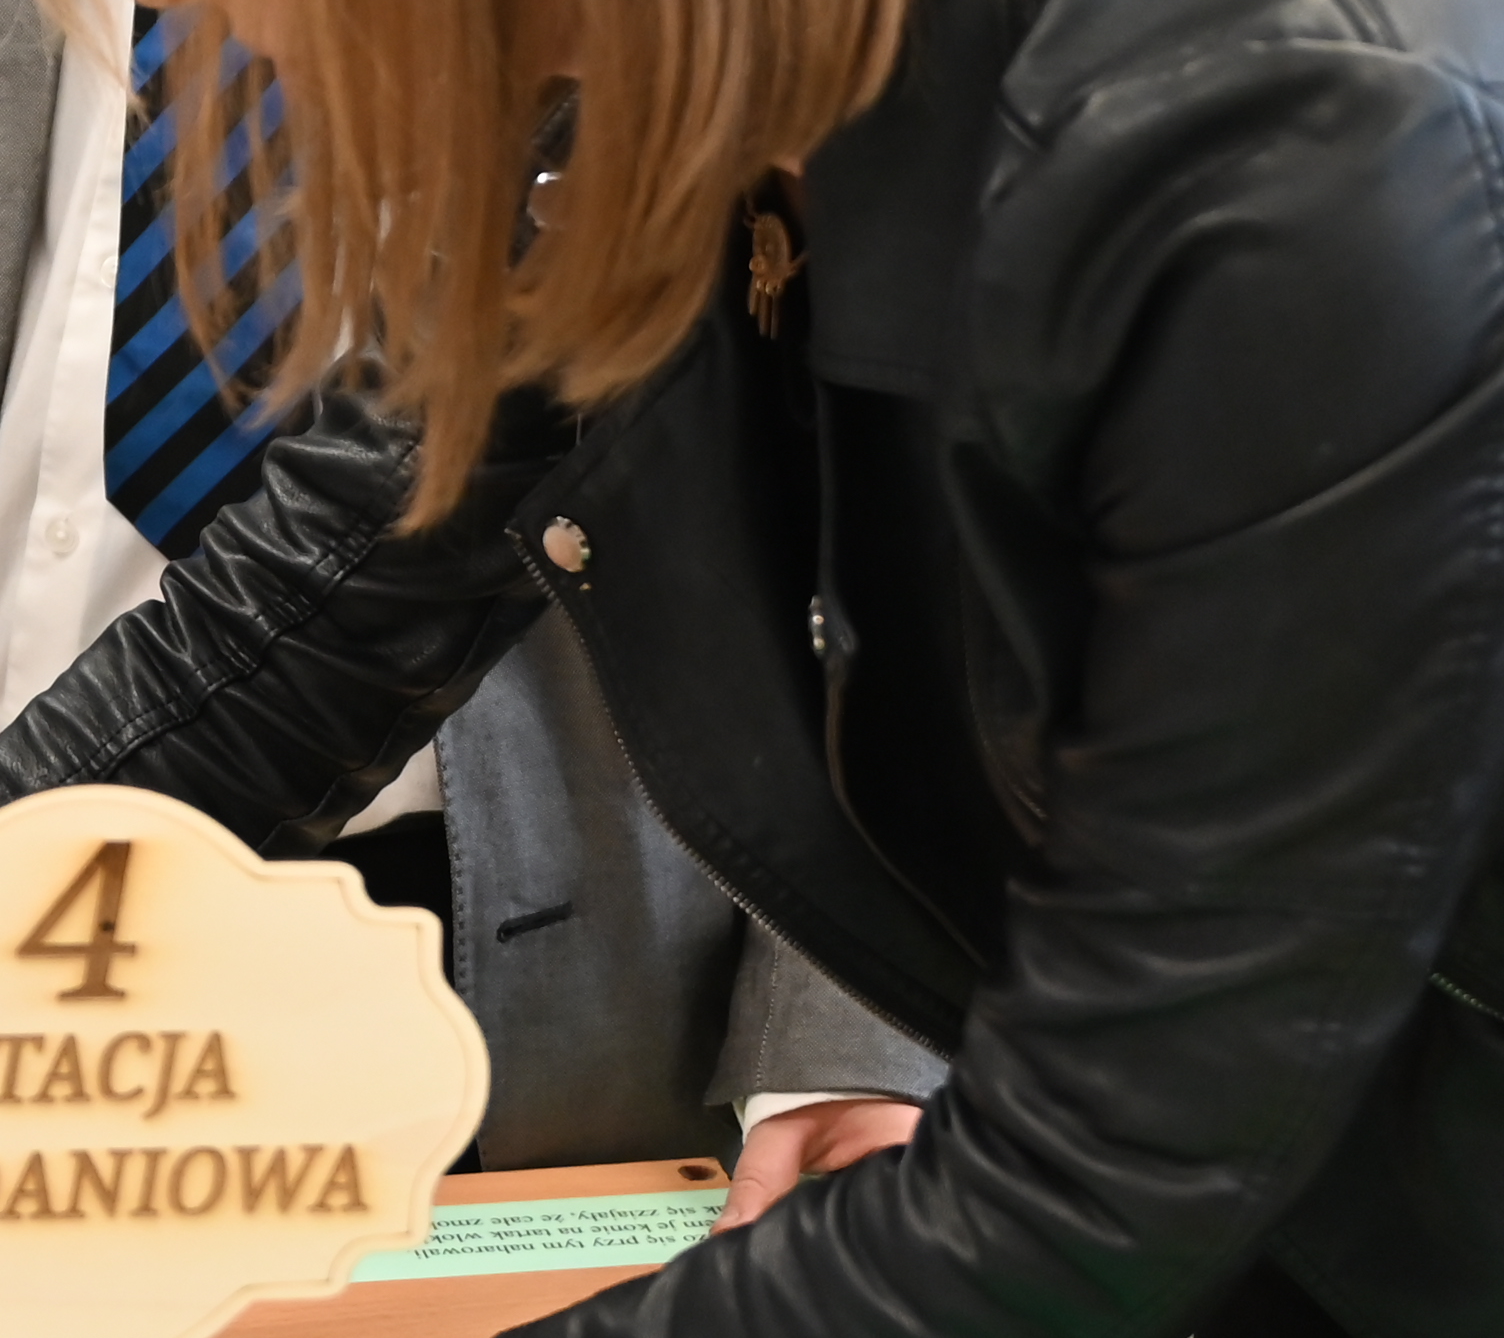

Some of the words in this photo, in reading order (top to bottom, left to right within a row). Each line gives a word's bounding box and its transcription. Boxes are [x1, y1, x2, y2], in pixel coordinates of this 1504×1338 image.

[14, 839, 137, 1002] 4
[558, 1226, 583, 1238] na
[592, 1220, 651, 1237] konie
[657, 1218, 677, 1232] je
[490, 1227, 551, 1243] tartak
[593, 1235, 639, 1248] przy
[647, 1234, 676, 1247] się
[543, 1237, 585, 1251] tym
